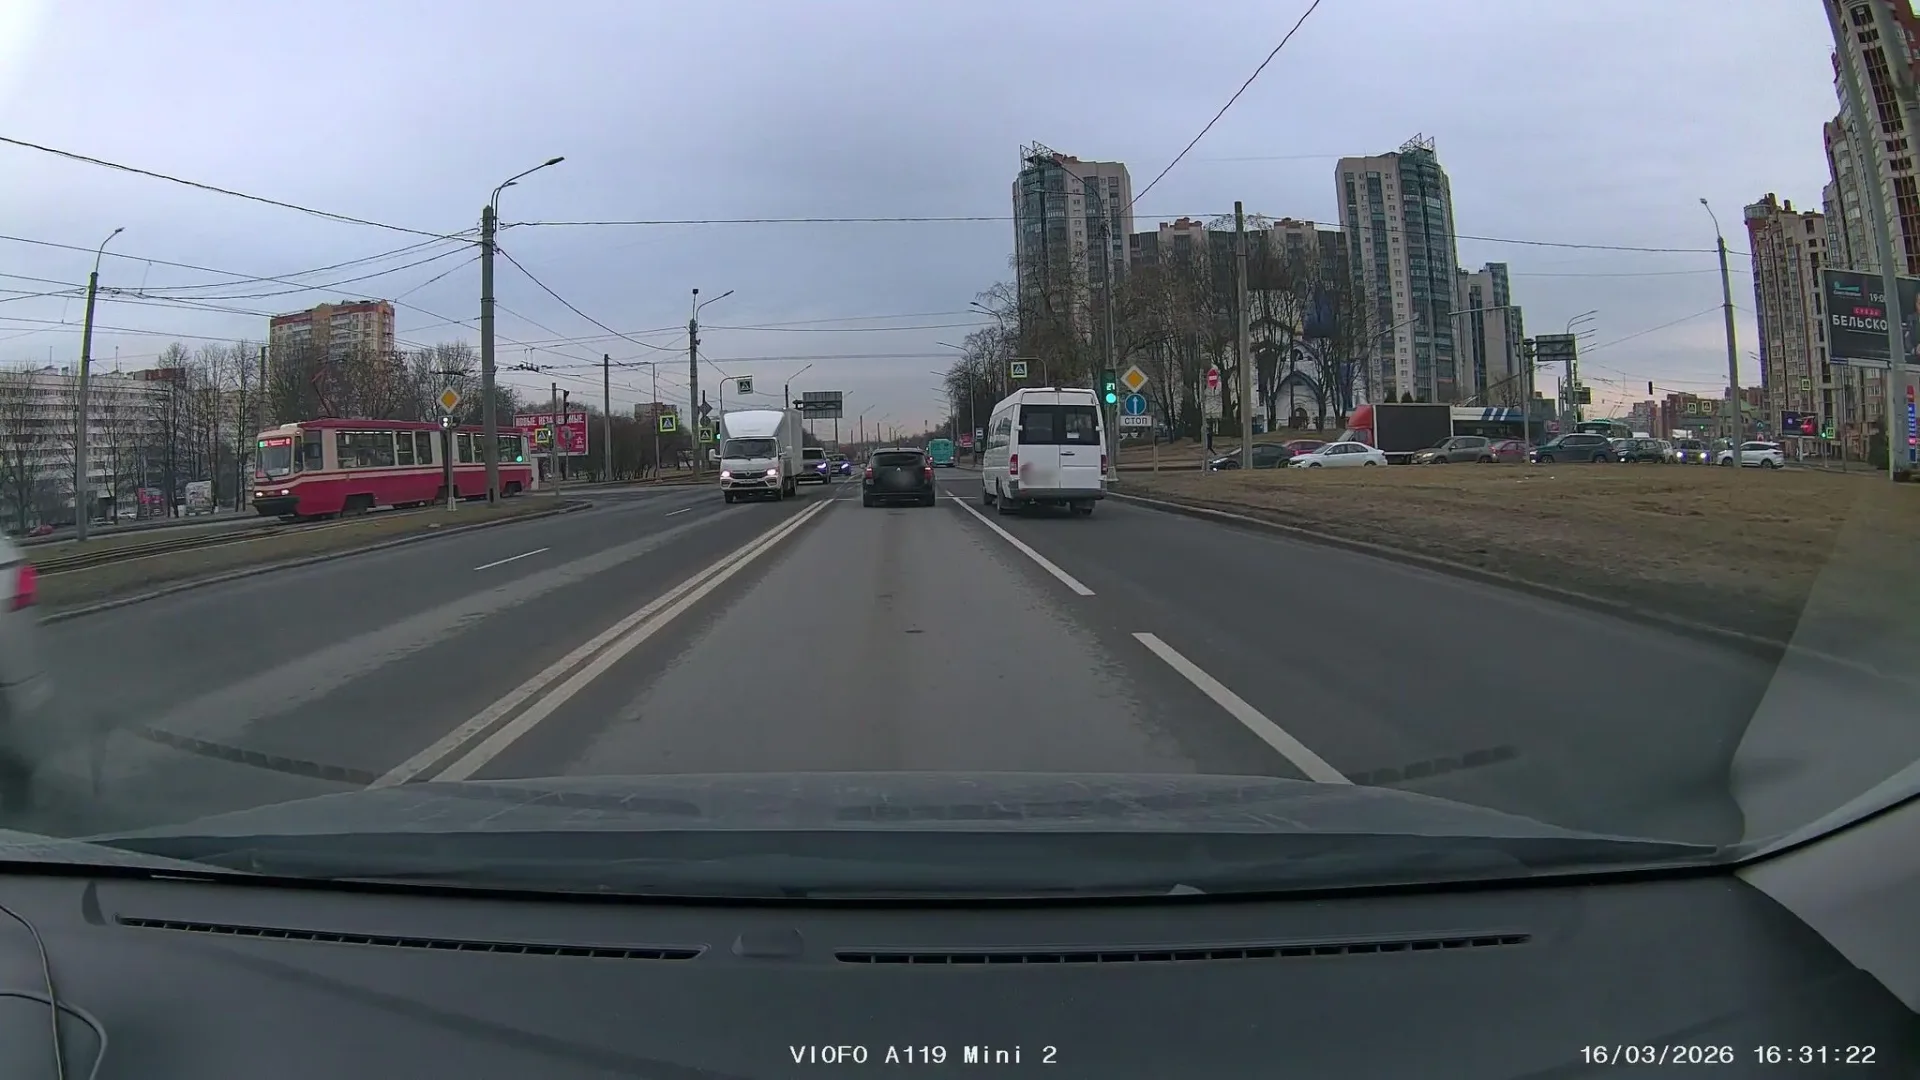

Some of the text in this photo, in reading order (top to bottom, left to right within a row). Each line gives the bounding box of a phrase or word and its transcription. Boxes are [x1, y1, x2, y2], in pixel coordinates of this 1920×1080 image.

[1868, 293, 1885, 303] 19:0
[1832, 314, 1889, 331] БЕЛЬСКО
[1124, 417, 1148, 425] СТОП
